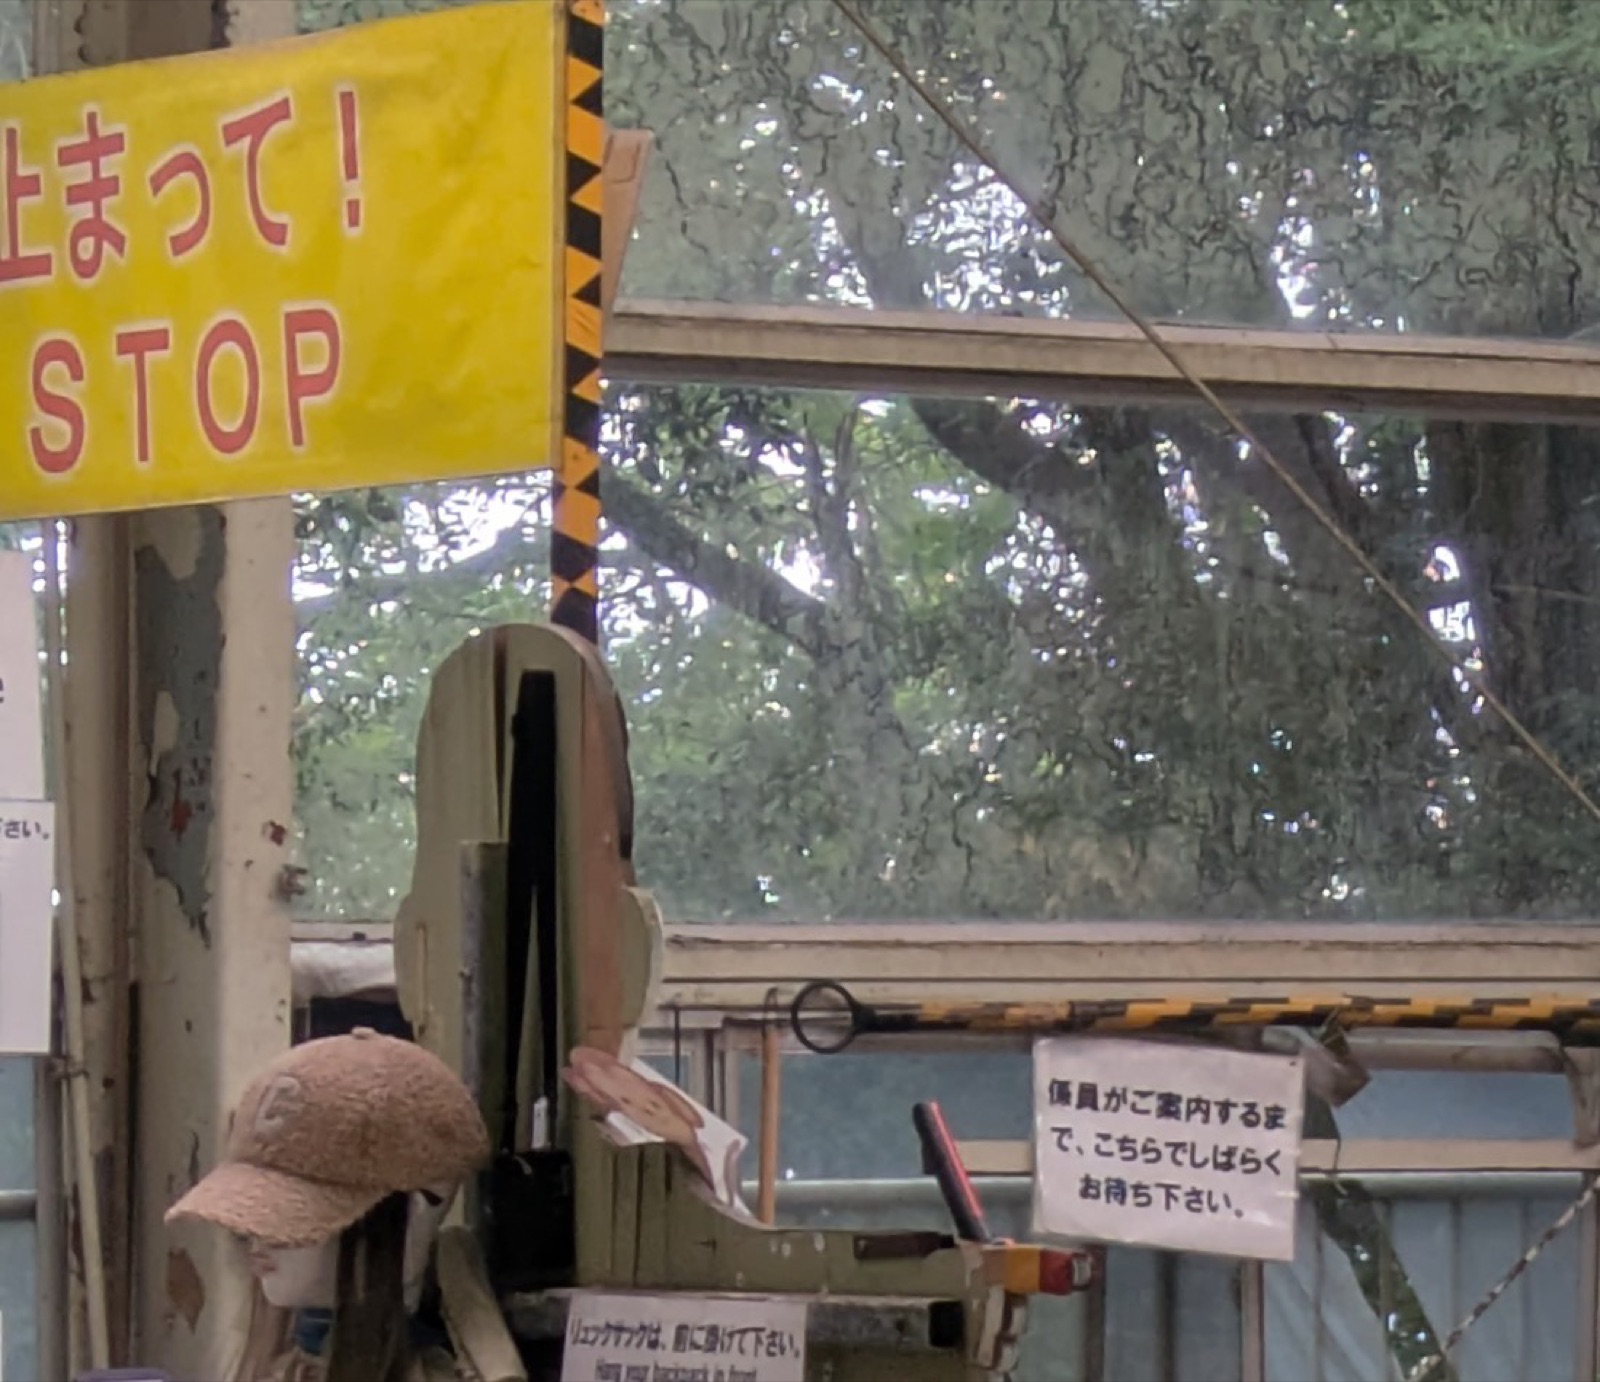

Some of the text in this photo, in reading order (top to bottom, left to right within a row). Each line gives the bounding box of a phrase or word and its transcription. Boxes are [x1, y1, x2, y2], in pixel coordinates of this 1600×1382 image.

[29, 308, 341, 474] STOP
[0, 819, 49, 840] さい。
[1049, 1078, 1287, 1130] 係員がご案内するま
[1051, 1126, 1282, 1175] で、こちらでしばらく
[1079, 1173, 1244, 1219] お待ち下さい。
